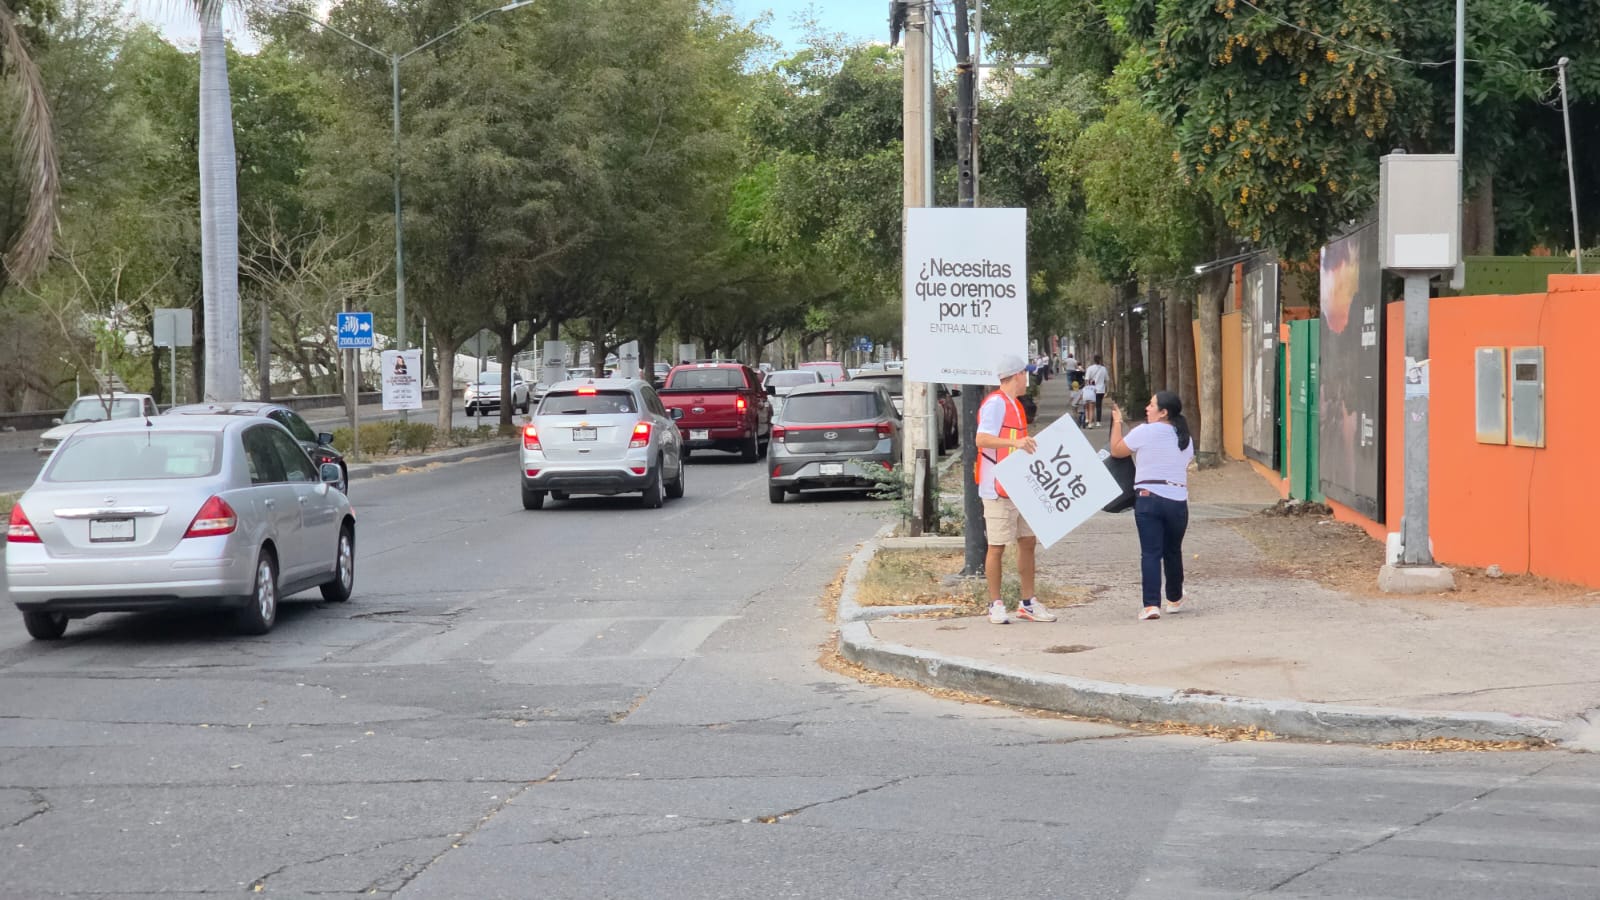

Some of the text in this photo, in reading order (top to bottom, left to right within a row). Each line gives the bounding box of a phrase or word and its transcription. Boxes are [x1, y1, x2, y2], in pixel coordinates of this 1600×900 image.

[919, 258, 1012, 281] ¿Necesitas
[915, 281, 1017, 301] que oremos
[939, 299, 992, 321] por ti?
[930, 323, 959, 333] ENTRA
[1050, 444, 1087, 498] Yo te
[1029, 459, 1076, 512] salvé
